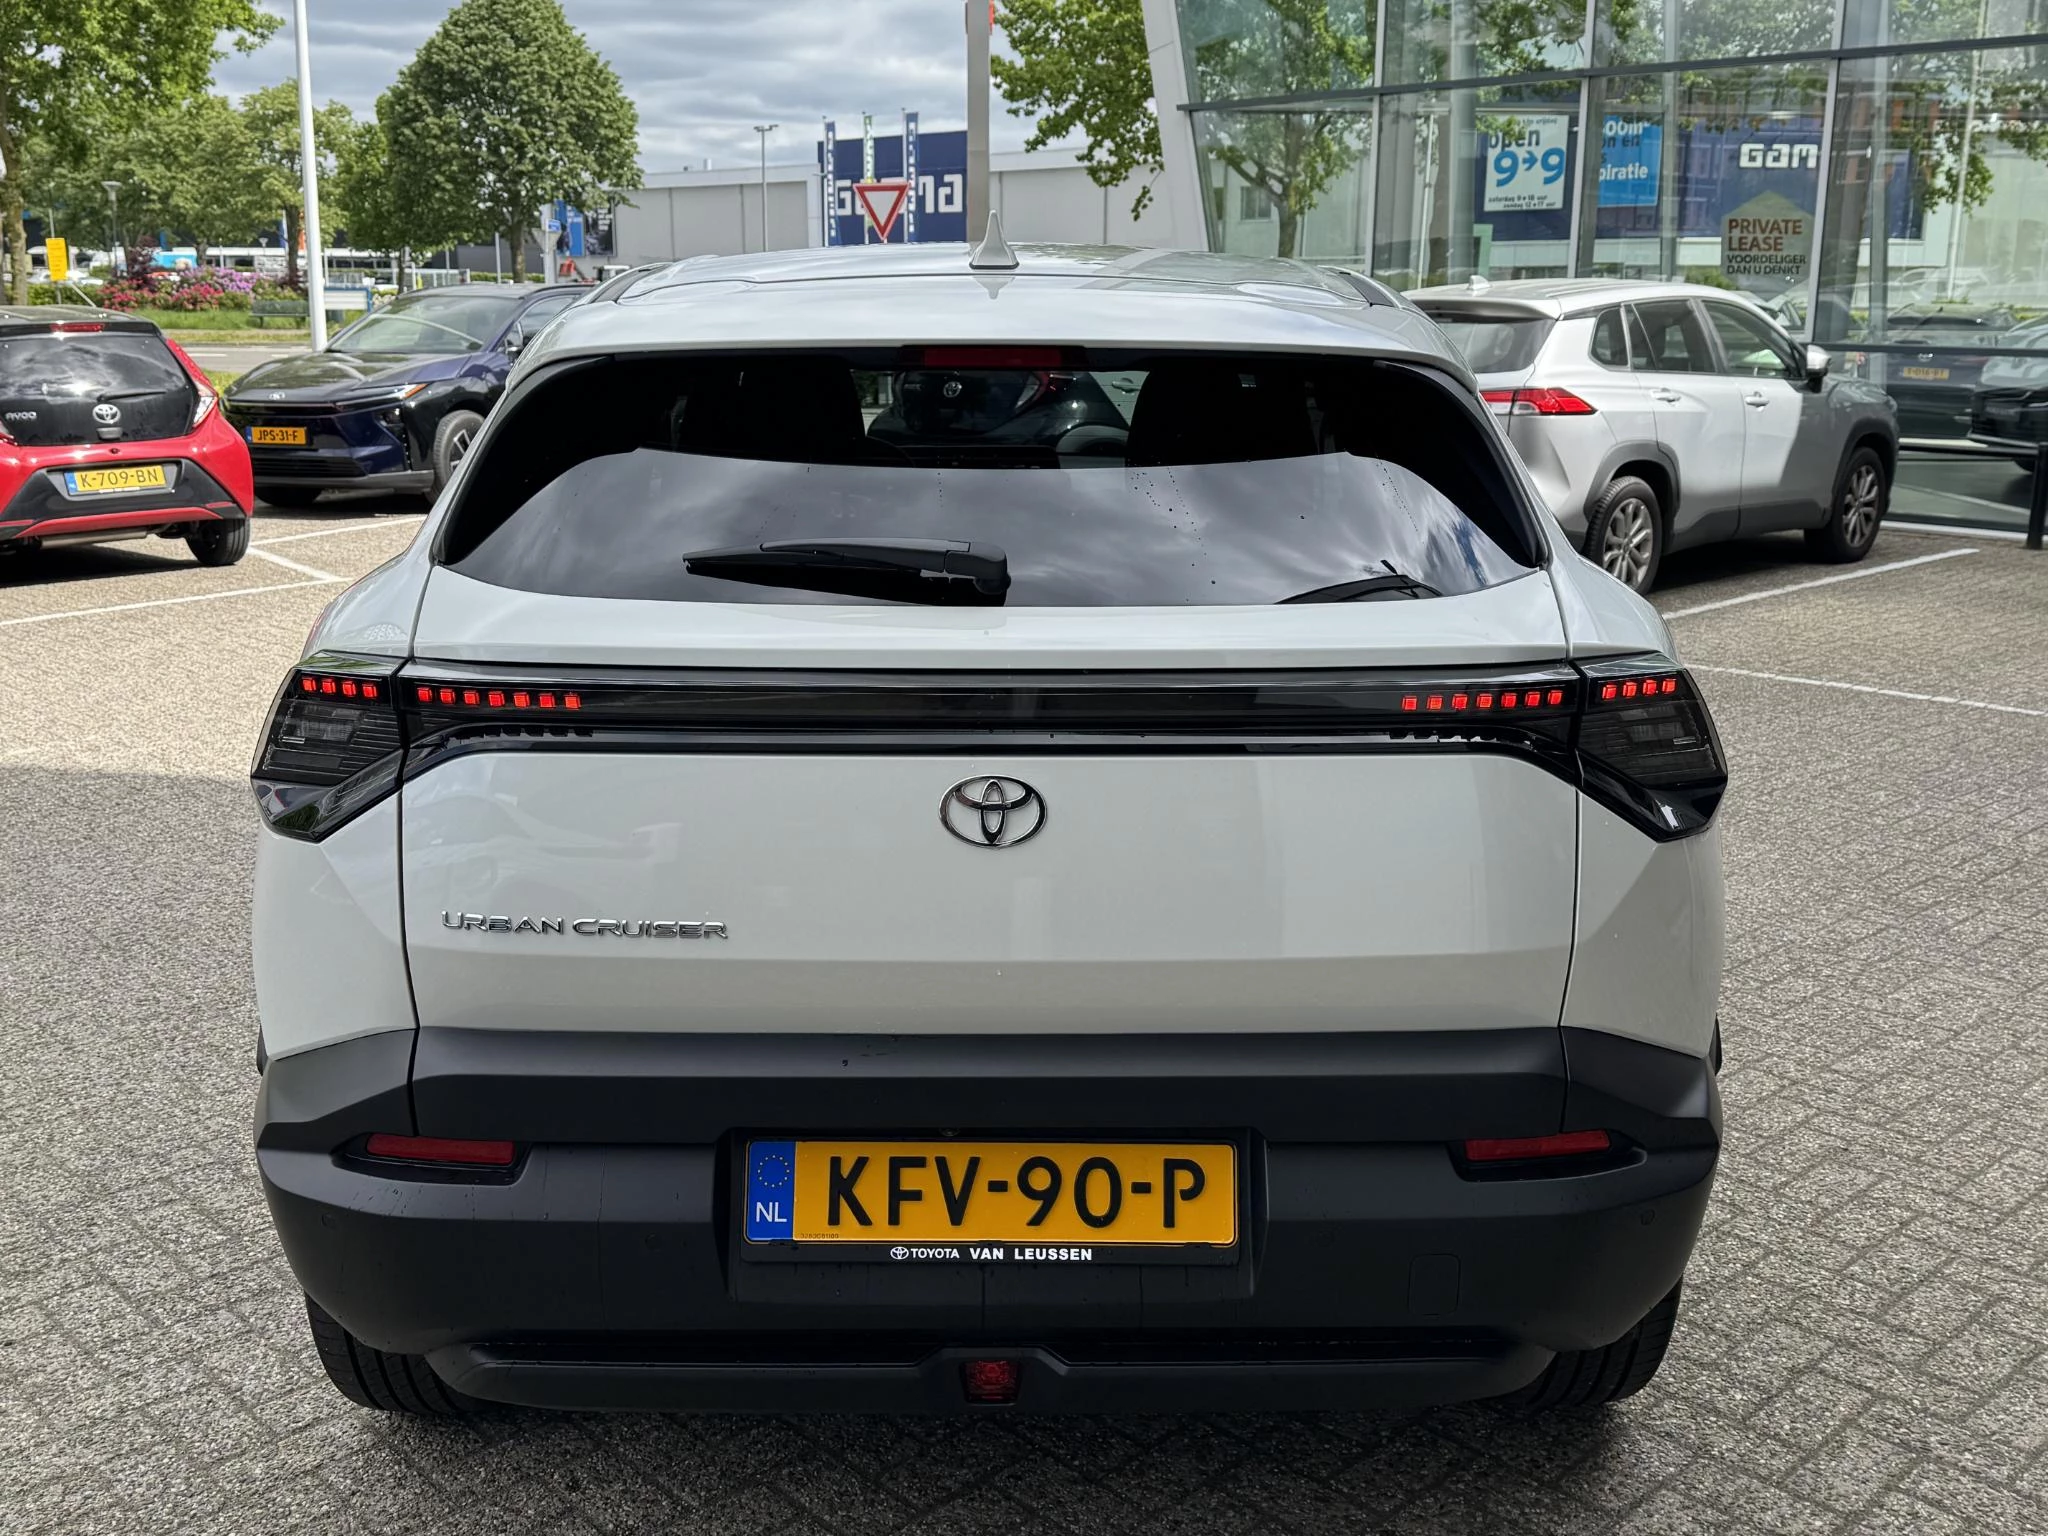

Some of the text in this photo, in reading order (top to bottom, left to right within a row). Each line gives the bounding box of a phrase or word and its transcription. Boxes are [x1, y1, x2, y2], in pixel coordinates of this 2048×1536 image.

[1489, 129, 1540, 152] open
[1728, 218, 1803, 236] PRIVATE
[1728, 236, 1784, 252] LEASE
[1727, 254, 1807, 265] VOORDELIGER
[1727, 265, 1801, 275] DAN U DENKT
[80, 468, 159, 489] K-709-BN
[441, 910, 728, 939] URBAN CRUISER
[827, 1156, 1206, 1228] KFV-90-P
[756, 1201, 788, 1223] NL
[911, 1248, 1093, 1261] TOYOTA VAN LEUSSEN
